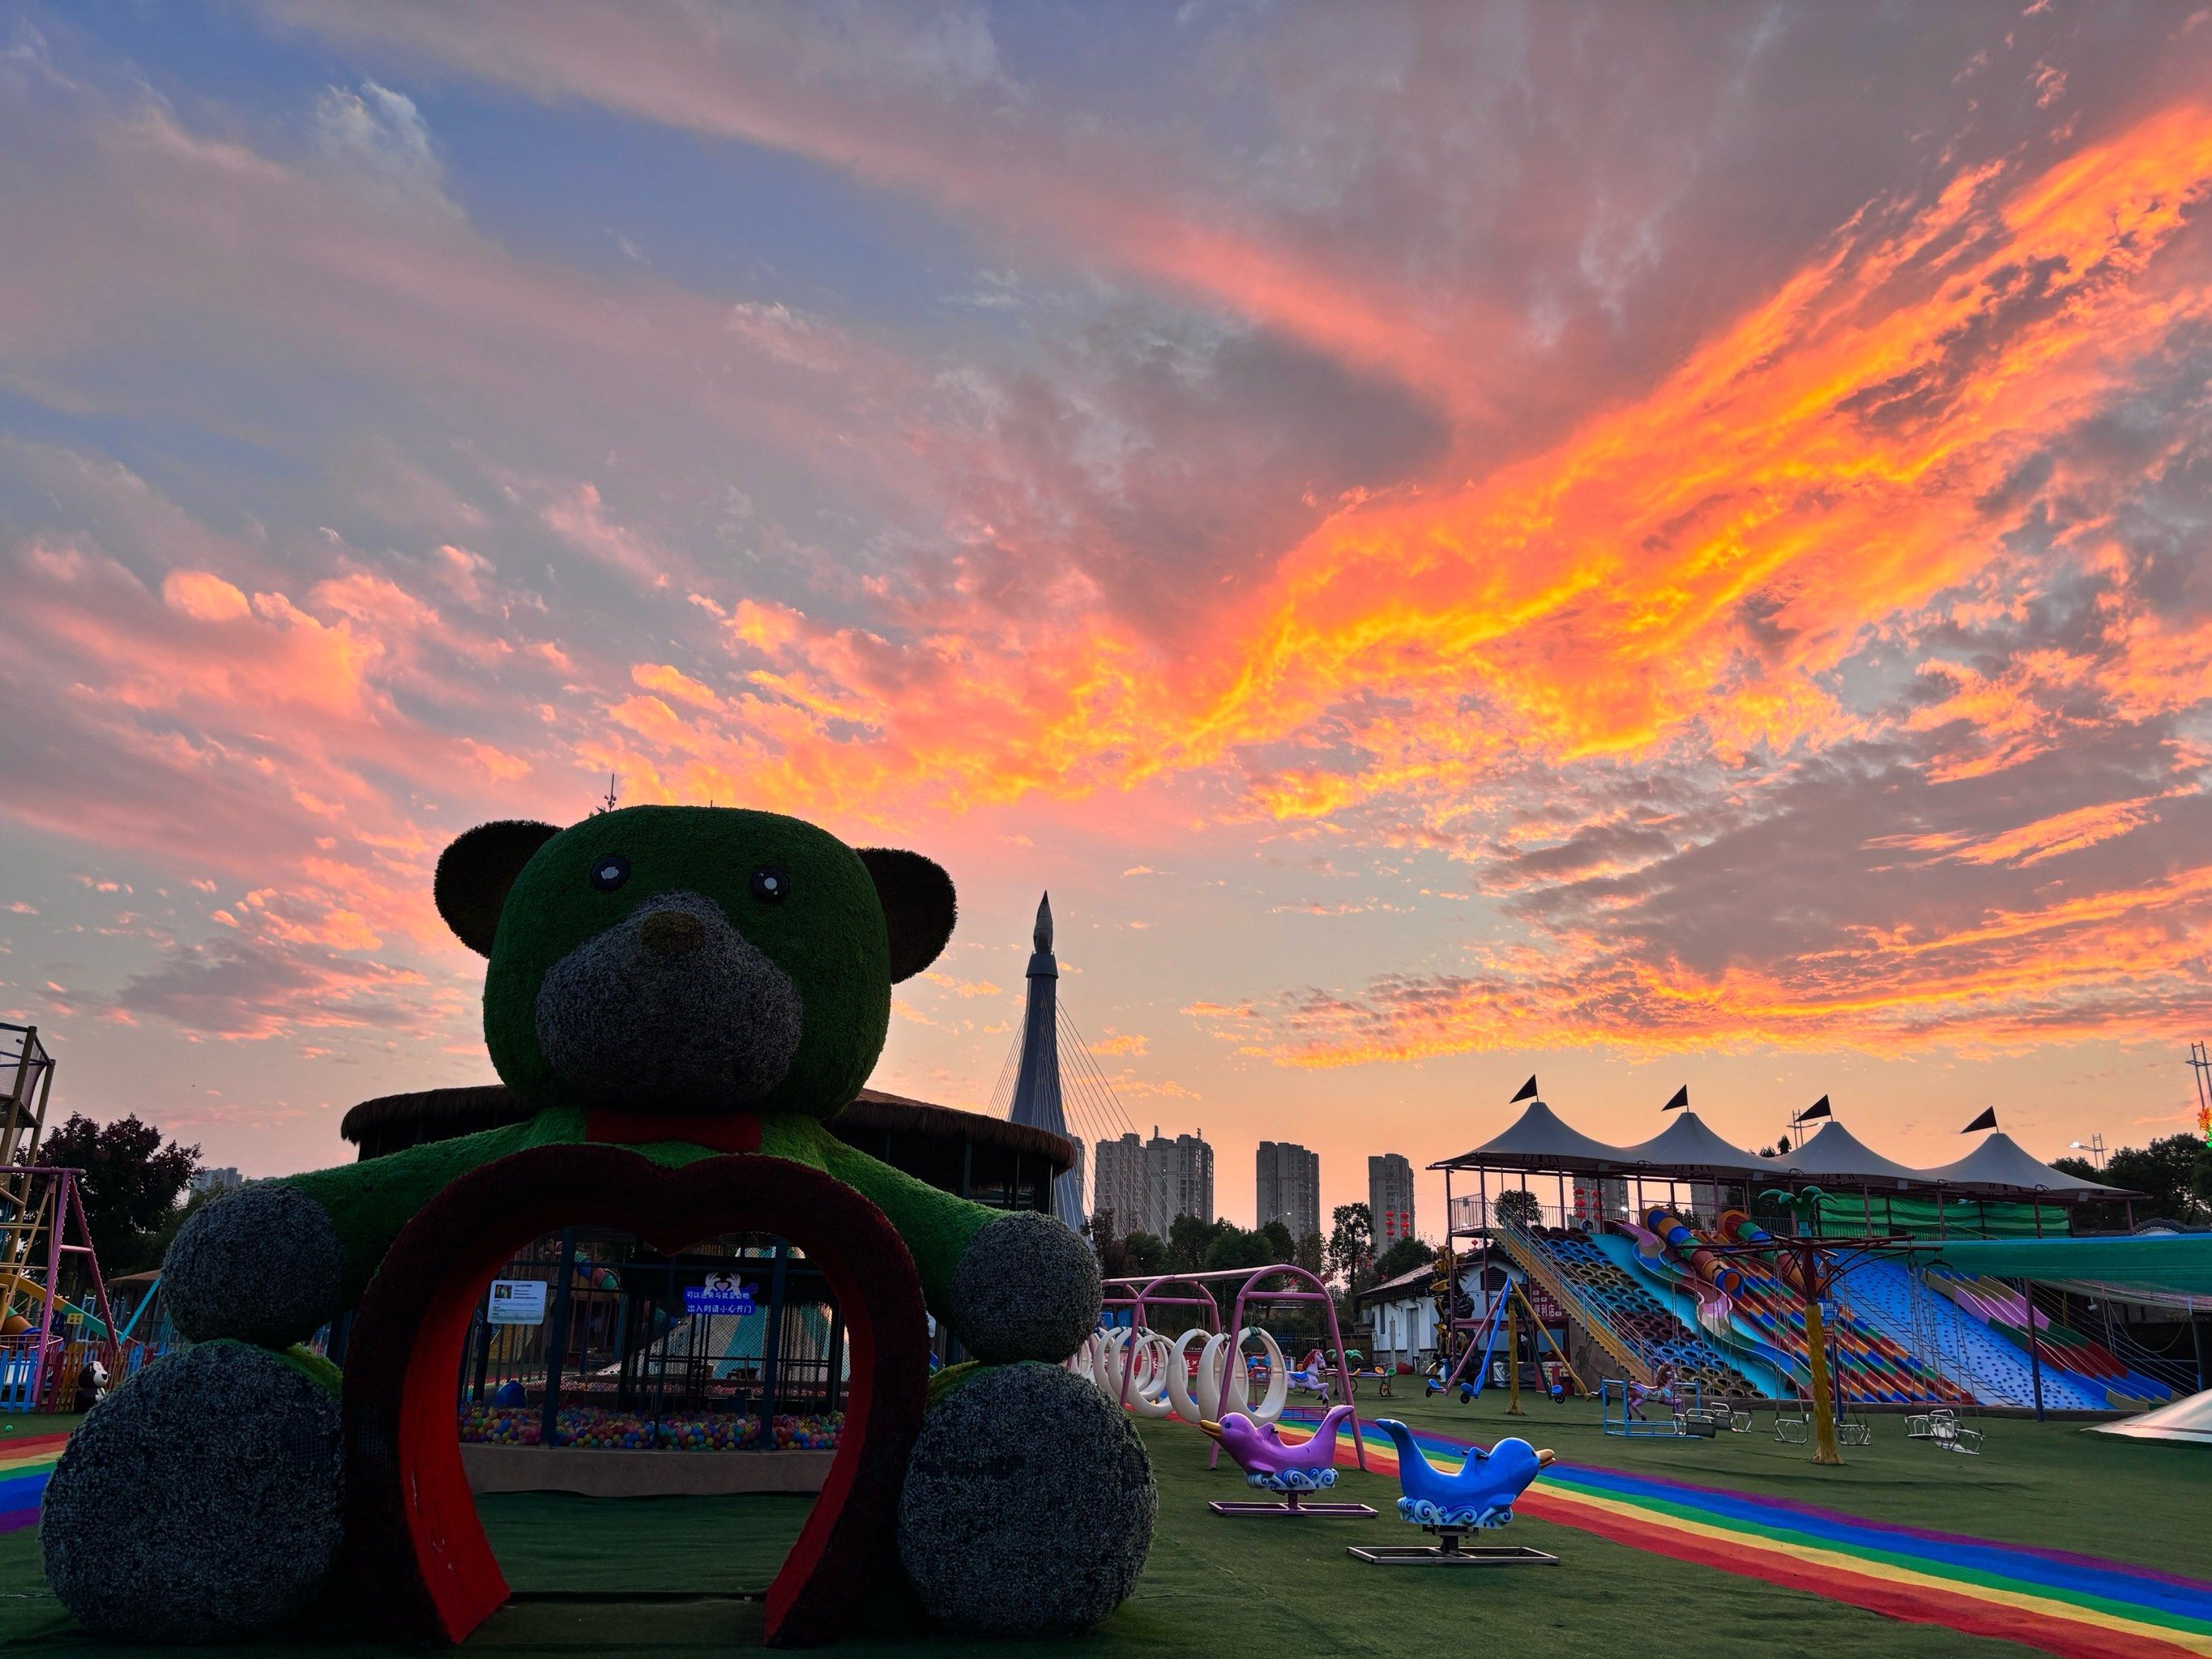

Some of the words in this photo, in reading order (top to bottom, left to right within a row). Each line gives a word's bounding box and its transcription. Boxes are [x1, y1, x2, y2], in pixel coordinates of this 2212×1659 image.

[687, 1304, 752, 1313] 出入时请小心开门
